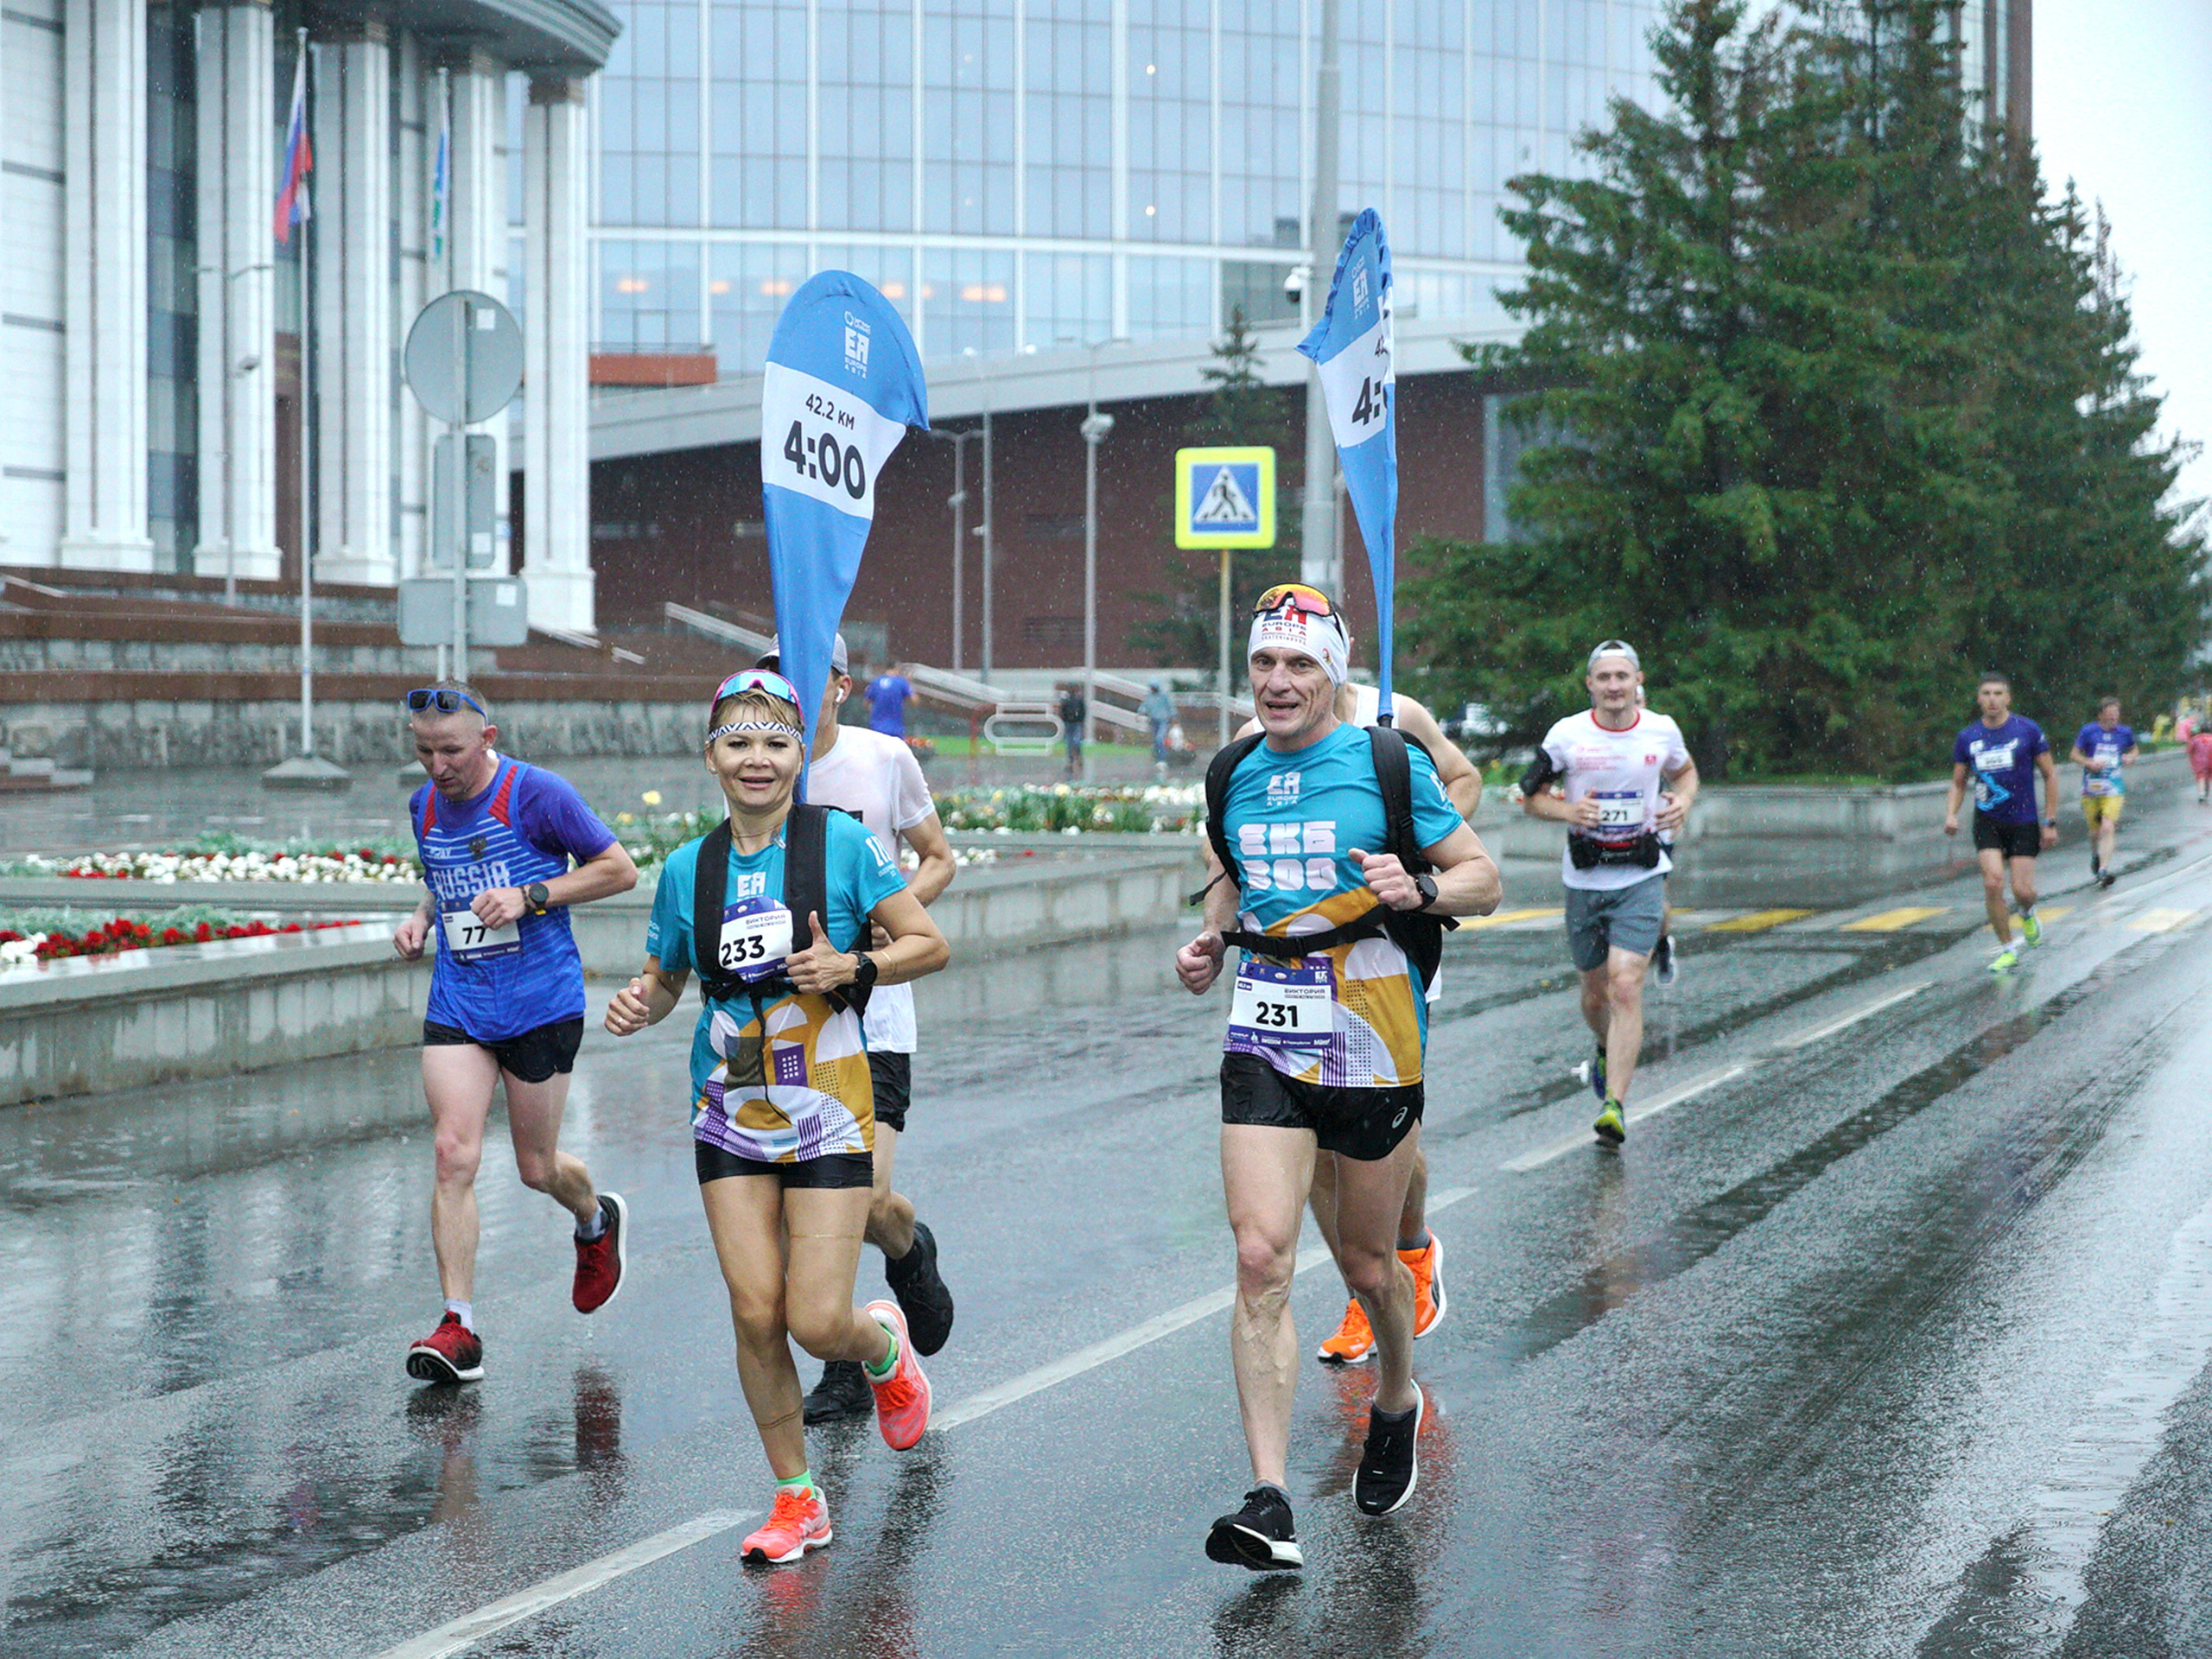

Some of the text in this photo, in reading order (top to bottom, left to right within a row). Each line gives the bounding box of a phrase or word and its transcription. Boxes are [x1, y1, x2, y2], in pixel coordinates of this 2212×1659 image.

[845, 326, 869, 364] EA
[805, 393, 835, 421] 42.2
[784, 420, 865, 499] 4:00
[1262, 621, 1306, 632] EUROPE
[1262, 626, 1306, 637] ASIA
[1267, 772, 1300, 794] EA
[1601, 810, 1628, 821] 271
[432, 861, 512, 900] RUSSIA
[737, 872, 766, 897] EA
[462, 925, 486, 944] 77
[721, 935, 766, 967] 233
[1255, 1001, 1298, 1027] 231
